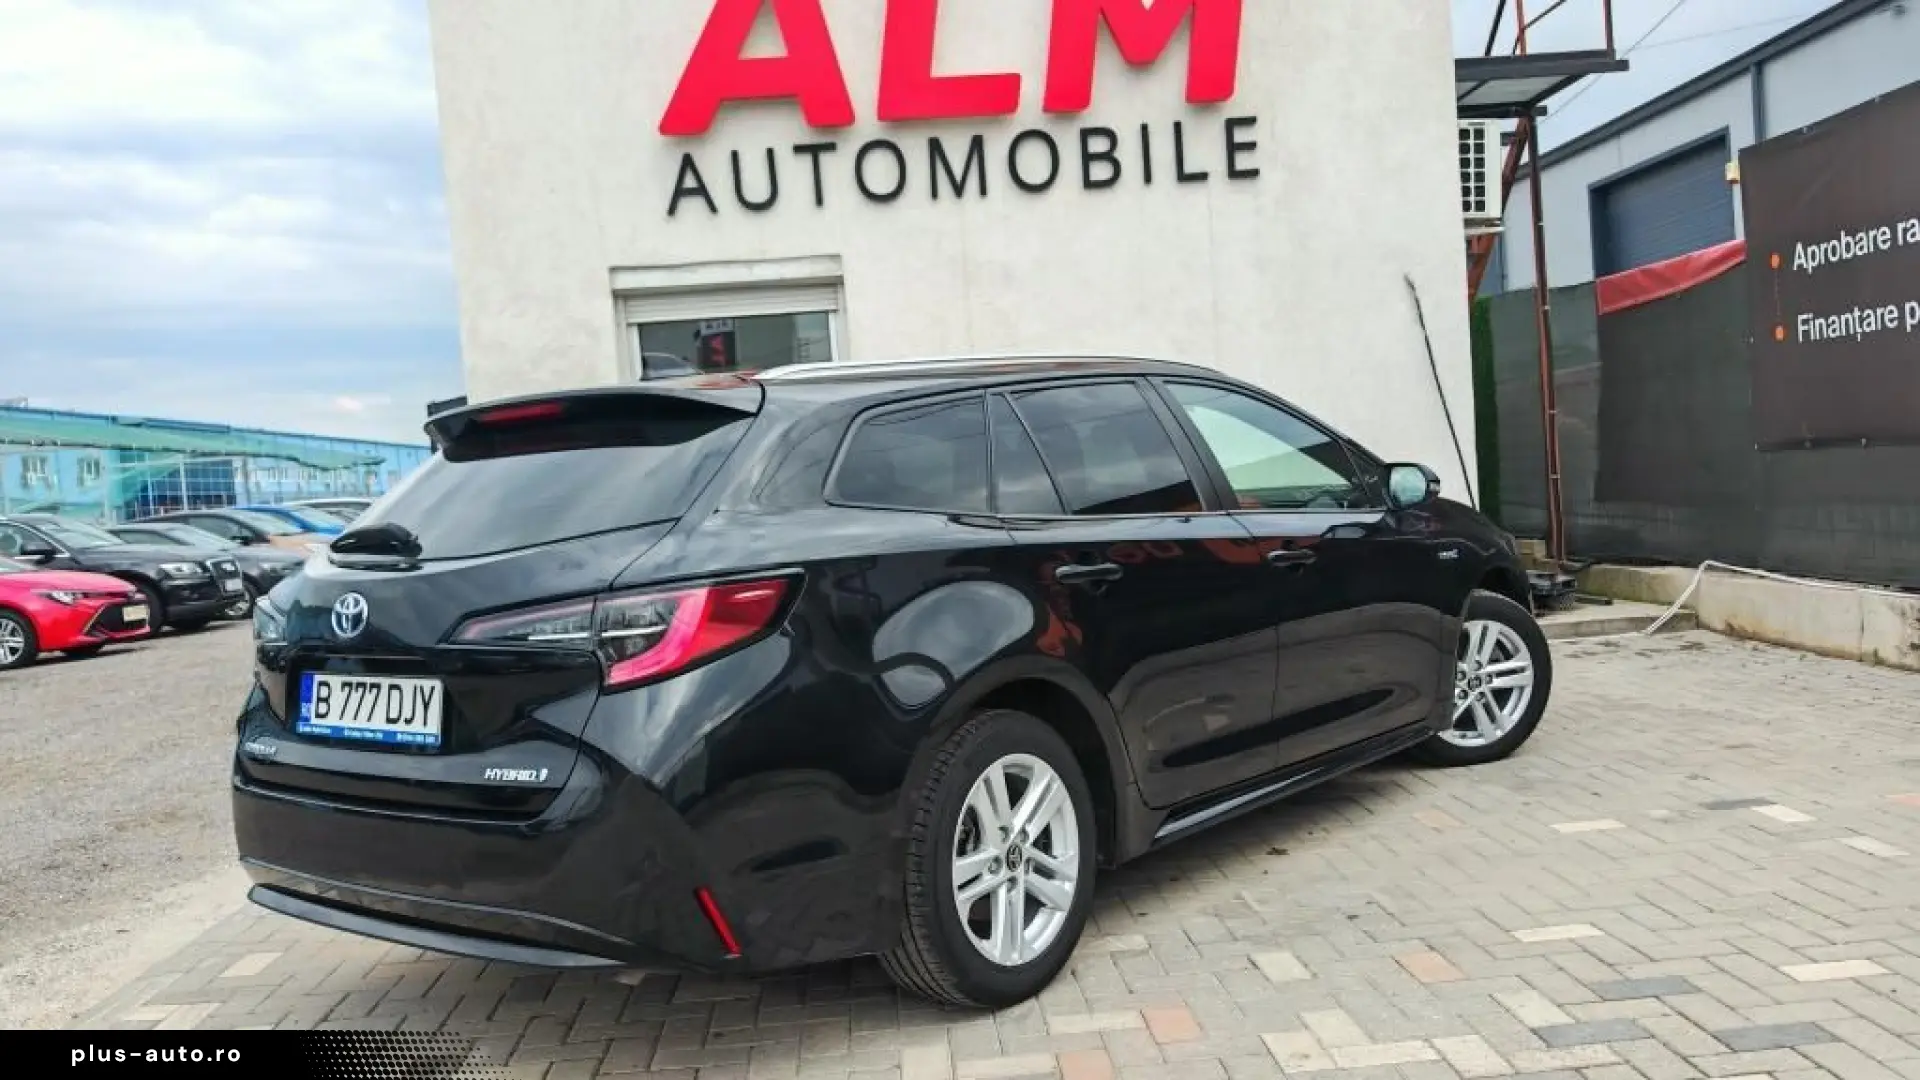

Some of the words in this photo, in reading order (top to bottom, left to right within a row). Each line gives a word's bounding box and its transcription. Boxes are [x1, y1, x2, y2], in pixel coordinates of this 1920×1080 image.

[659, 0, 1242, 135] ALM
[667, 116, 1260, 217] AUTOMOBILE
[1793, 226, 1891, 274] Aprobare
[1797, 304, 1899, 343] Finanțare
[1905, 301, 1920, 333] p
[314, 680, 332, 718] B
[339, 681, 381, 722] 777
[386, 684, 435, 727] DJY
